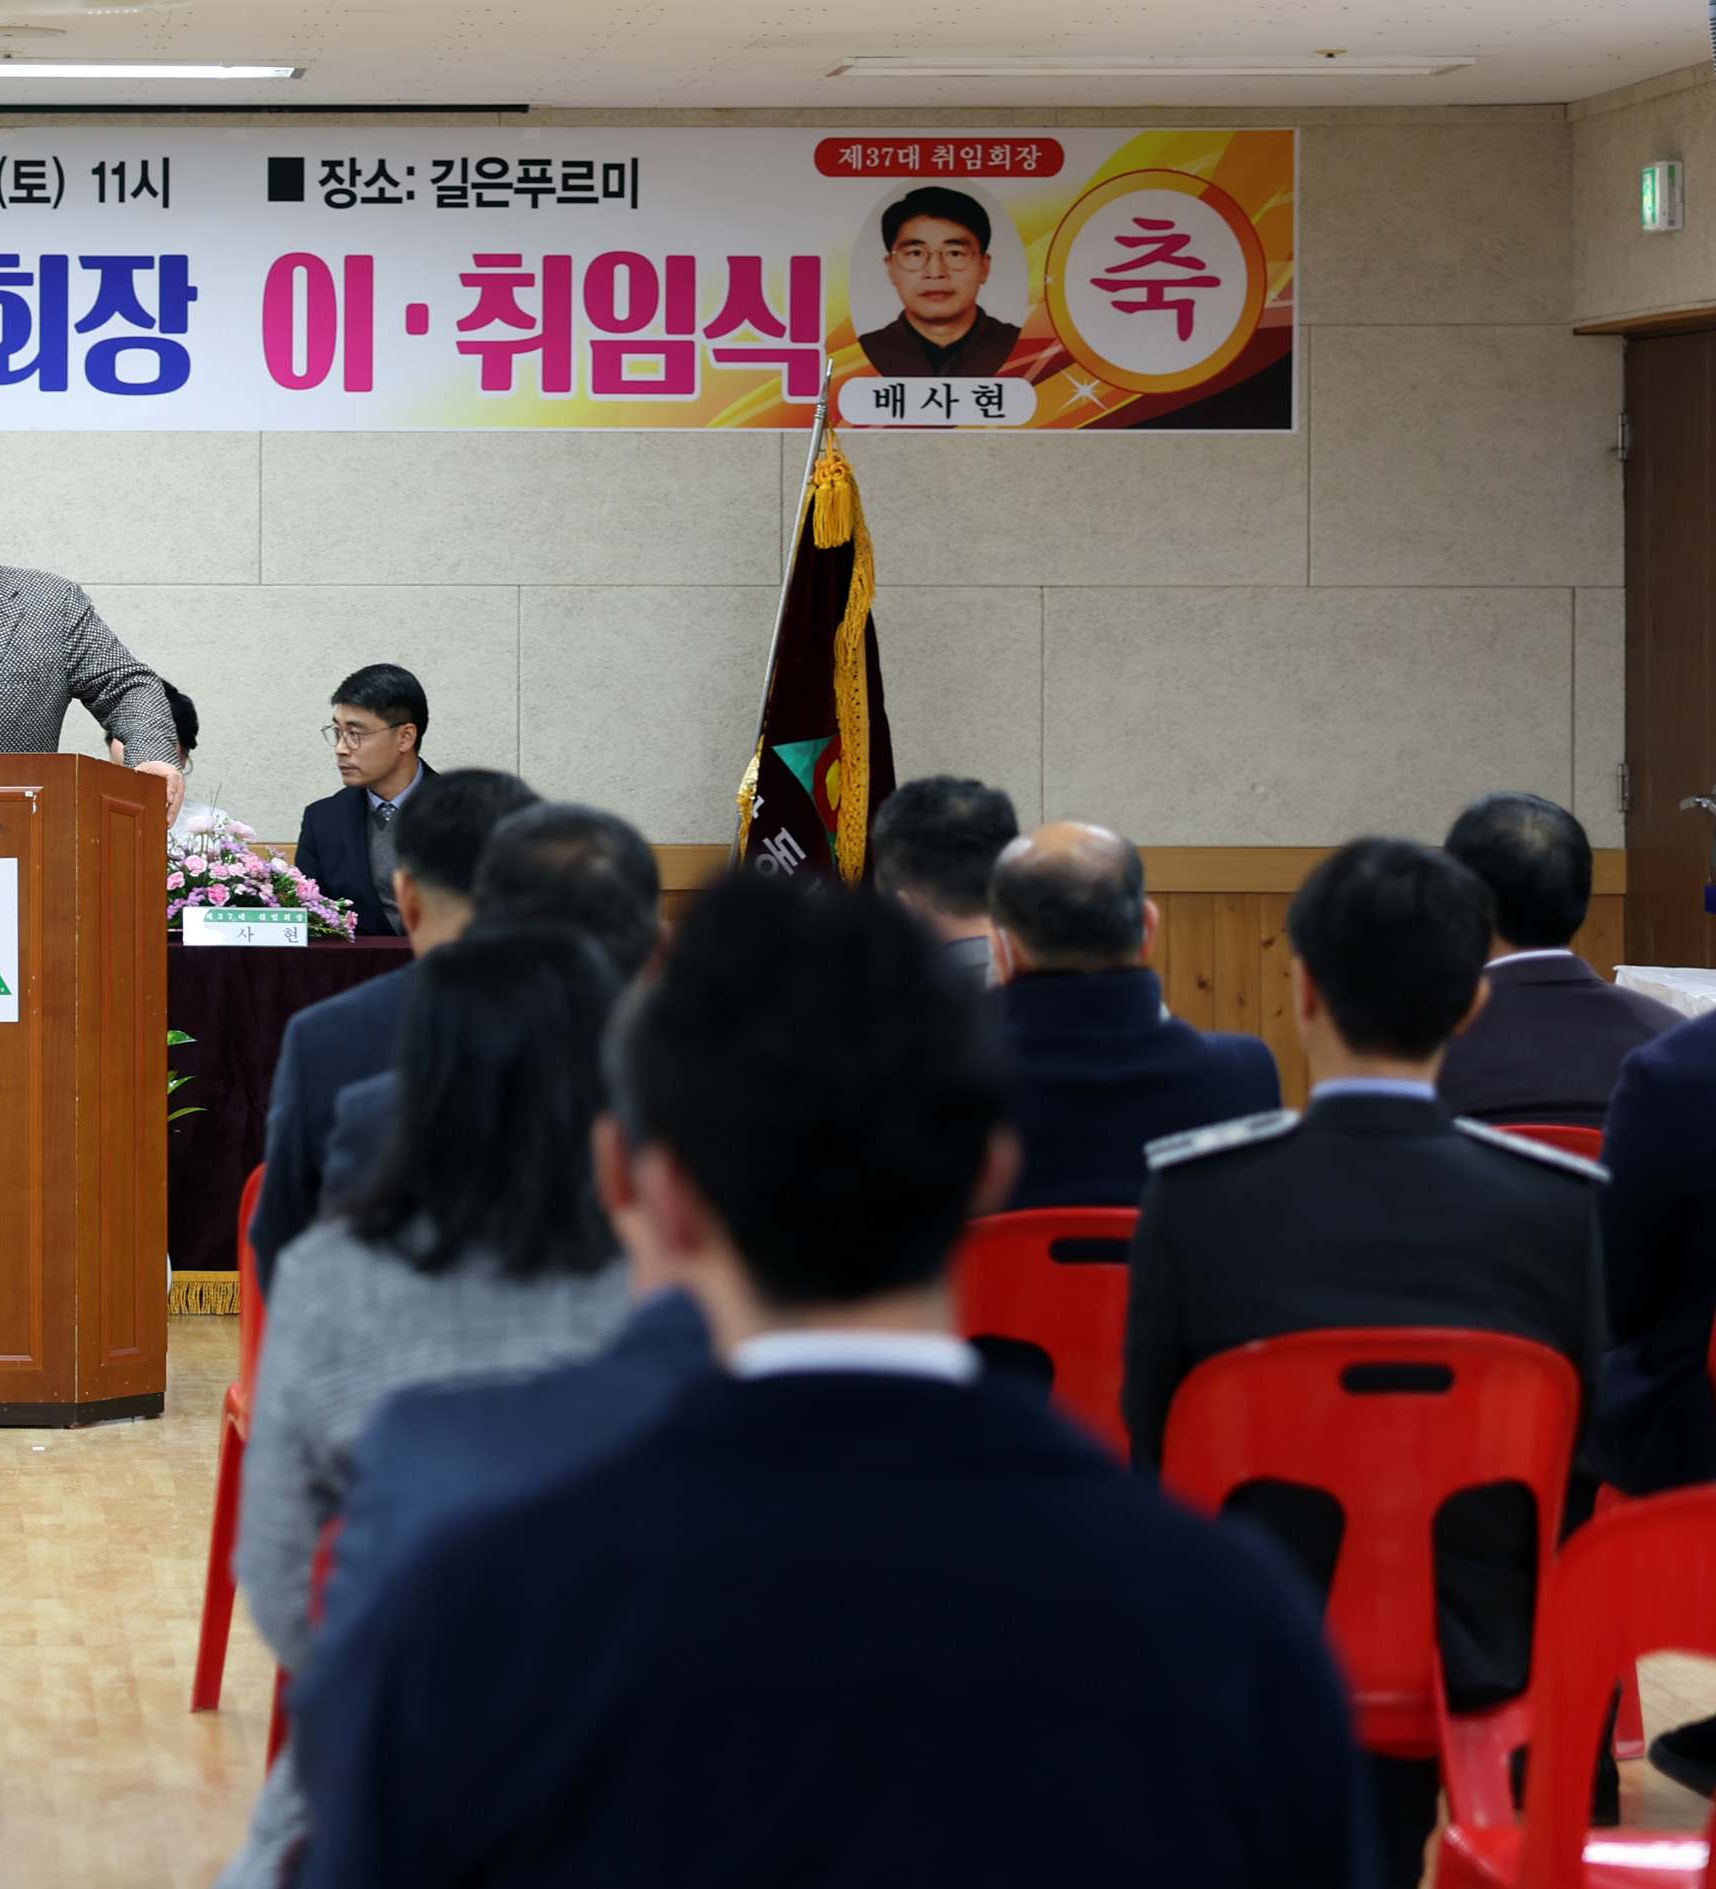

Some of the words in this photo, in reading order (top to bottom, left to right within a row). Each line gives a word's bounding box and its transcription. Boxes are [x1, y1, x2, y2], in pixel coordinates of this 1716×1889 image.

[90, 155, 171, 209] 11시
[318, 156, 415, 209] 장소:
[430, 156, 639, 209] 길은푸르미
[838, 143, 921, 171] 제37대
[930, 143, 1042, 172] 취임회장
[1090, 216, 1222, 342] 축
